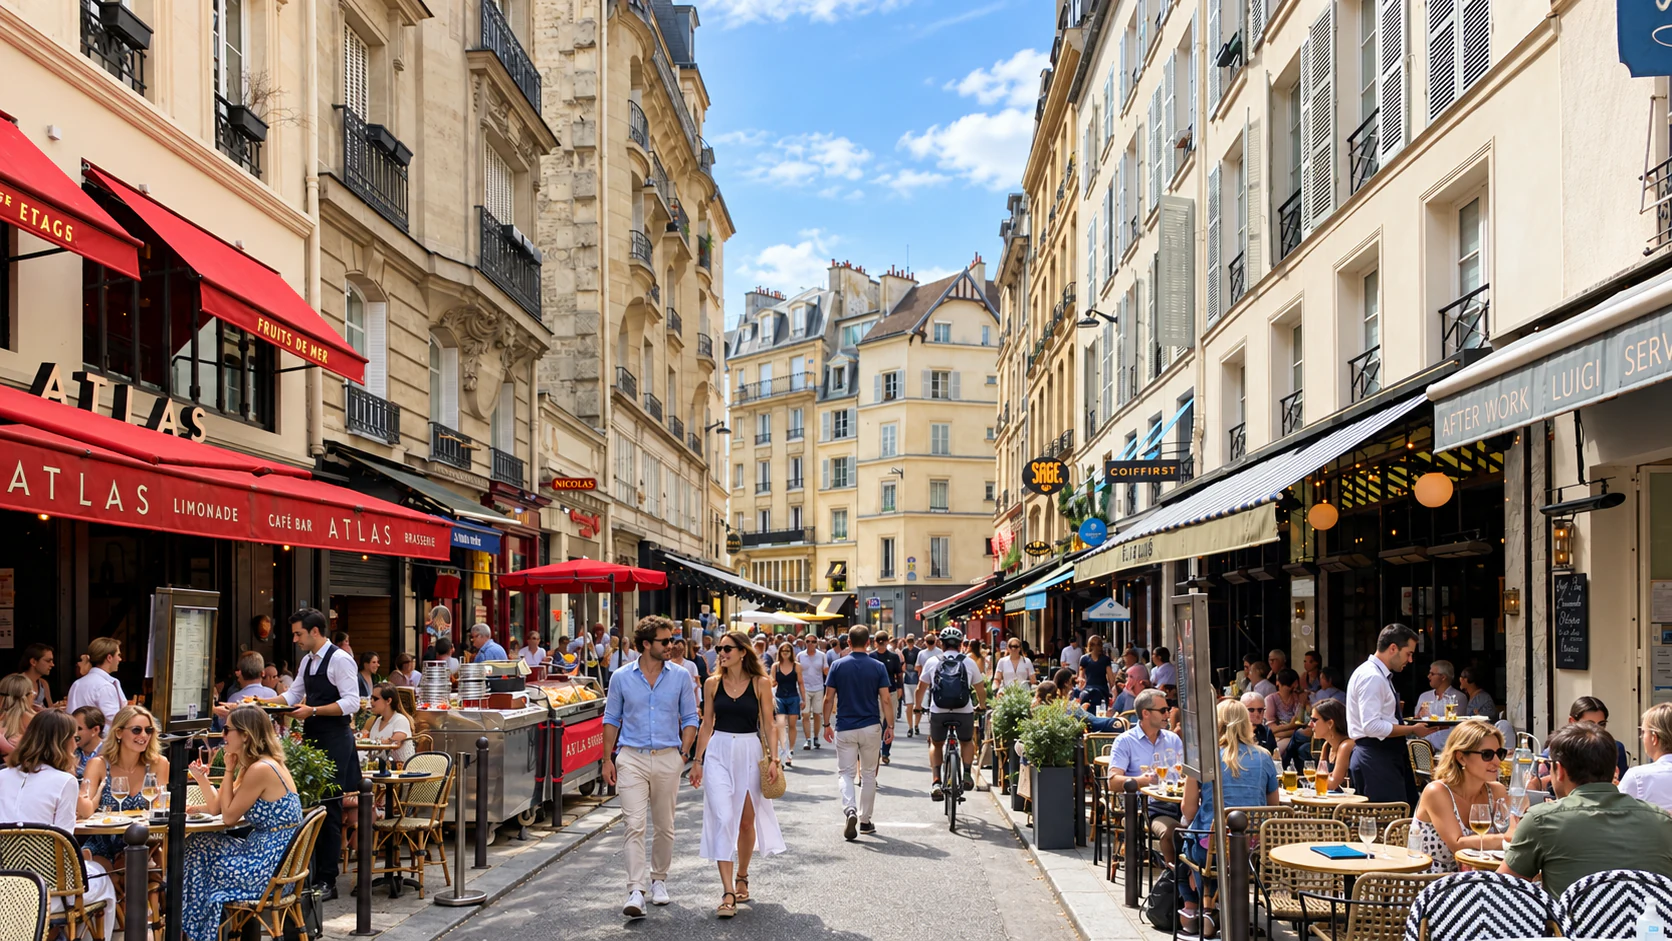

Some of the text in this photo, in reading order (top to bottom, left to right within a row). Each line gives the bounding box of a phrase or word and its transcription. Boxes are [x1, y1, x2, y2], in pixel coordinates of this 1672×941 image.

[20, 202, 73, 242] ETAGS
[257, 317, 328, 364] FRUITS DE MER
[28, 362, 207, 443] ATLAS
[1442, 405, 1480, 438] AFTER
[1485, 386, 1529, 425] WORK
[1552, 358, 1600, 402] LUIGI
[554, 479, 594, 489] NICOLAS
[1110, 466, 1177, 477] COIFFIRST
[7, 459, 149, 516] ATLAS
[173, 498, 239, 523] LIMONADE
[268, 513, 292, 530] CAFÉ
[295, 517, 313, 532] BAR
[328, 517, 392, 546] ATLAS
